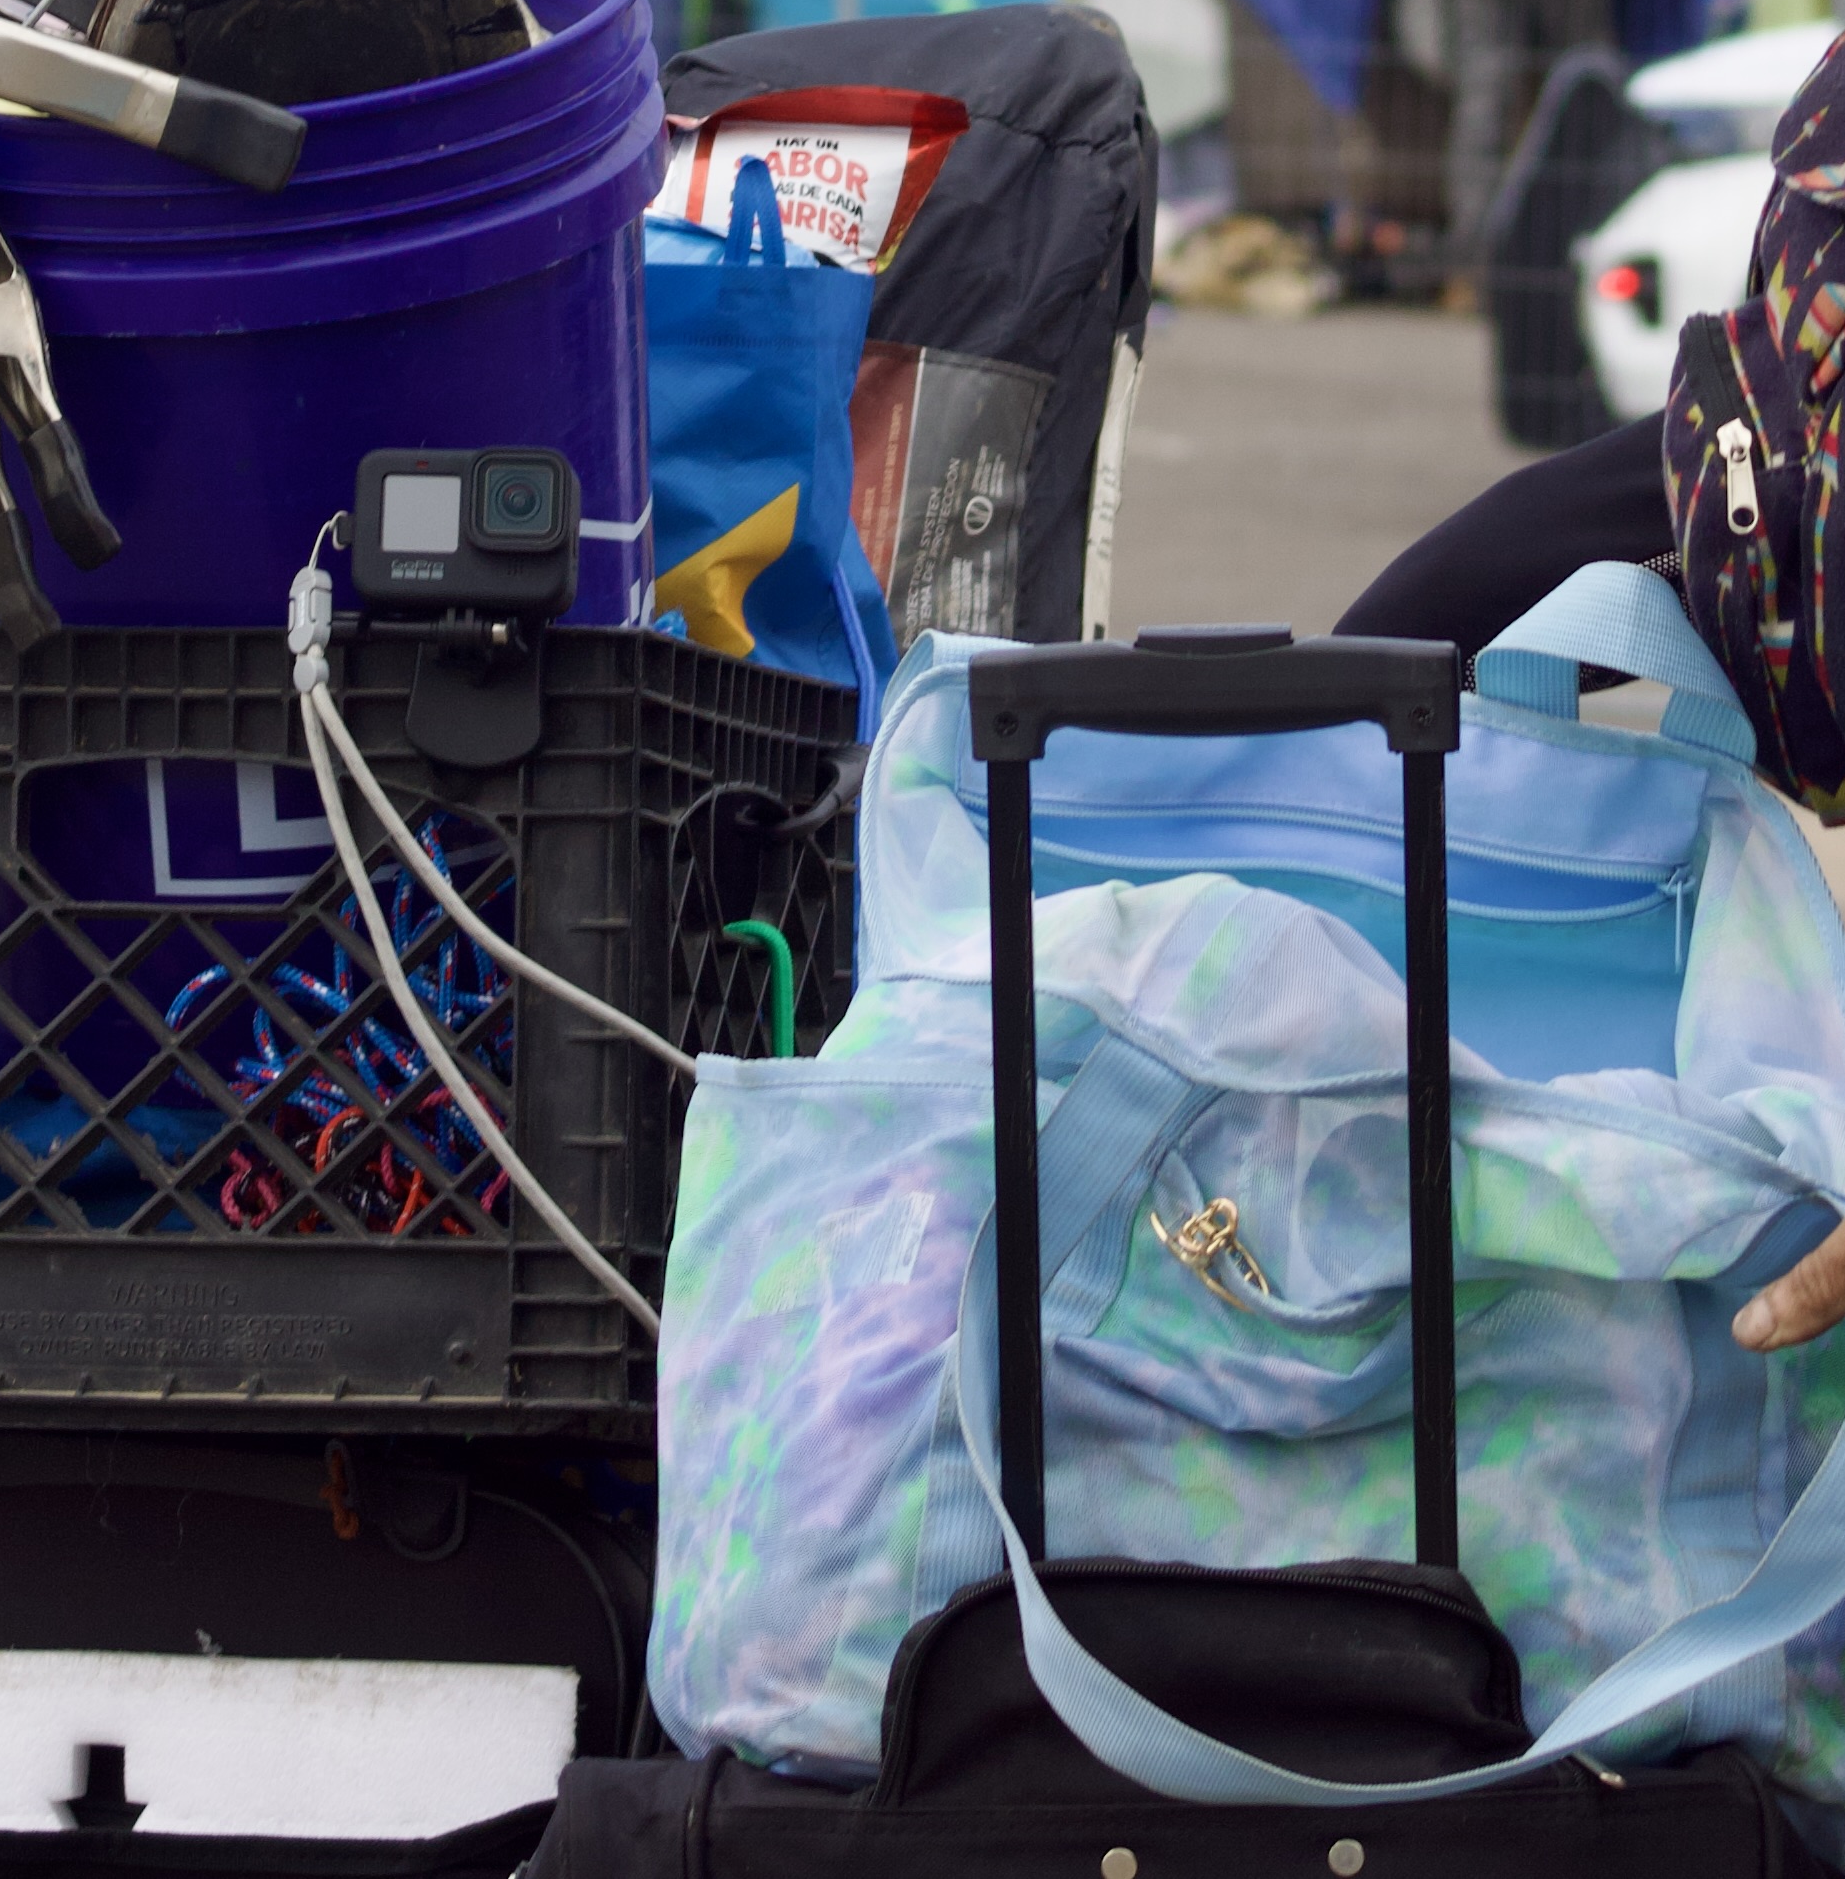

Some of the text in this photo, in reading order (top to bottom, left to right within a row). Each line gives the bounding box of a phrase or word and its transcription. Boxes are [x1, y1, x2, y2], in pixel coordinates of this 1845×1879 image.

[775, 137, 840, 150] HAY UN
[734, 149, 869, 202] ABOR
[799, 183, 822, 200] DE
[826, 190, 864, 222] CADA
[391, 559, 445, 569] GoPro
[107, 1279, 239, 1307] WARNING
[39, 1310, 67, 1330] BY
[75, 1311, 146, 1332] OTHER
[154, 1313, 215, 1334] THAN
[220, 1313, 354, 1335] REGISTERED
[20, 1336, 326, 1360] OWNER PUNISHABLE BY LAW
